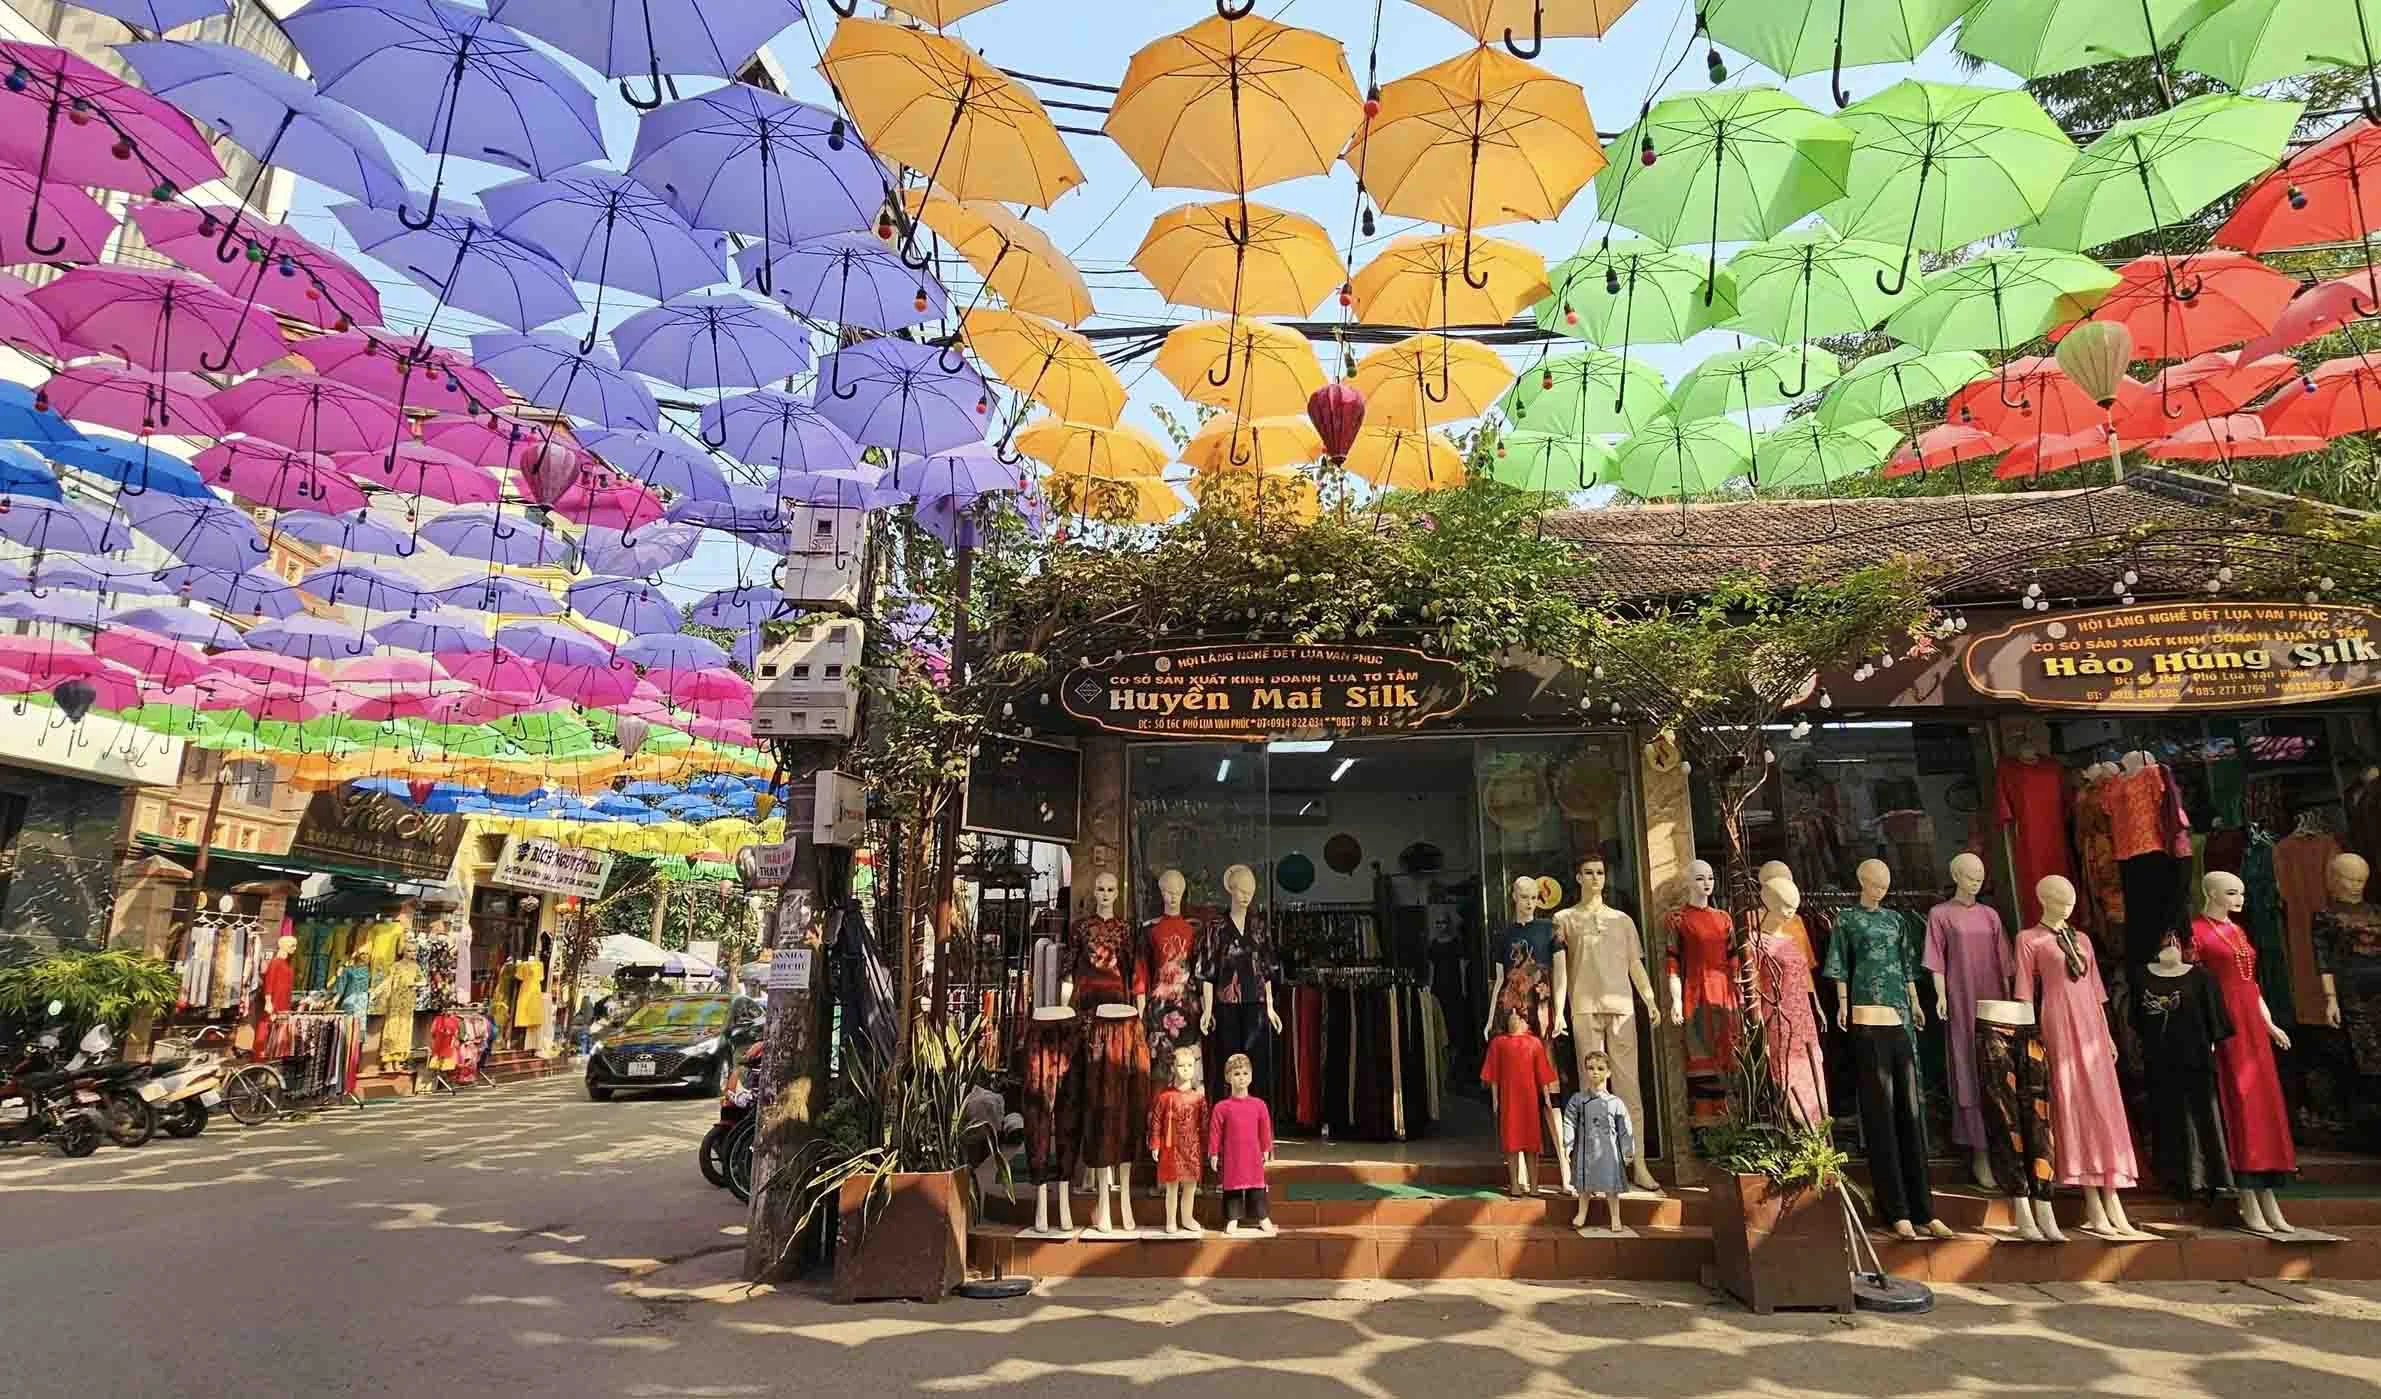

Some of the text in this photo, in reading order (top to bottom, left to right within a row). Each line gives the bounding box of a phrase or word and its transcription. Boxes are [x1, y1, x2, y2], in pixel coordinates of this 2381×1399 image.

[2078, 621, 2103, 632] HỘI
[2287, 608, 2329, 622] PHÚC
[2165, 633, 2206, 646] KINH
[2042, 637, 2381, 676] Hảo Hùng Silk
[1231, 674, 1265, 685] KINH
[1271, 674, 1321, 685] DOANH
[1109, 682, 1230, 716] Huyền
[1252, 686, 1323, 709] Mai
[1345, 684, 1419, 708] Silk
